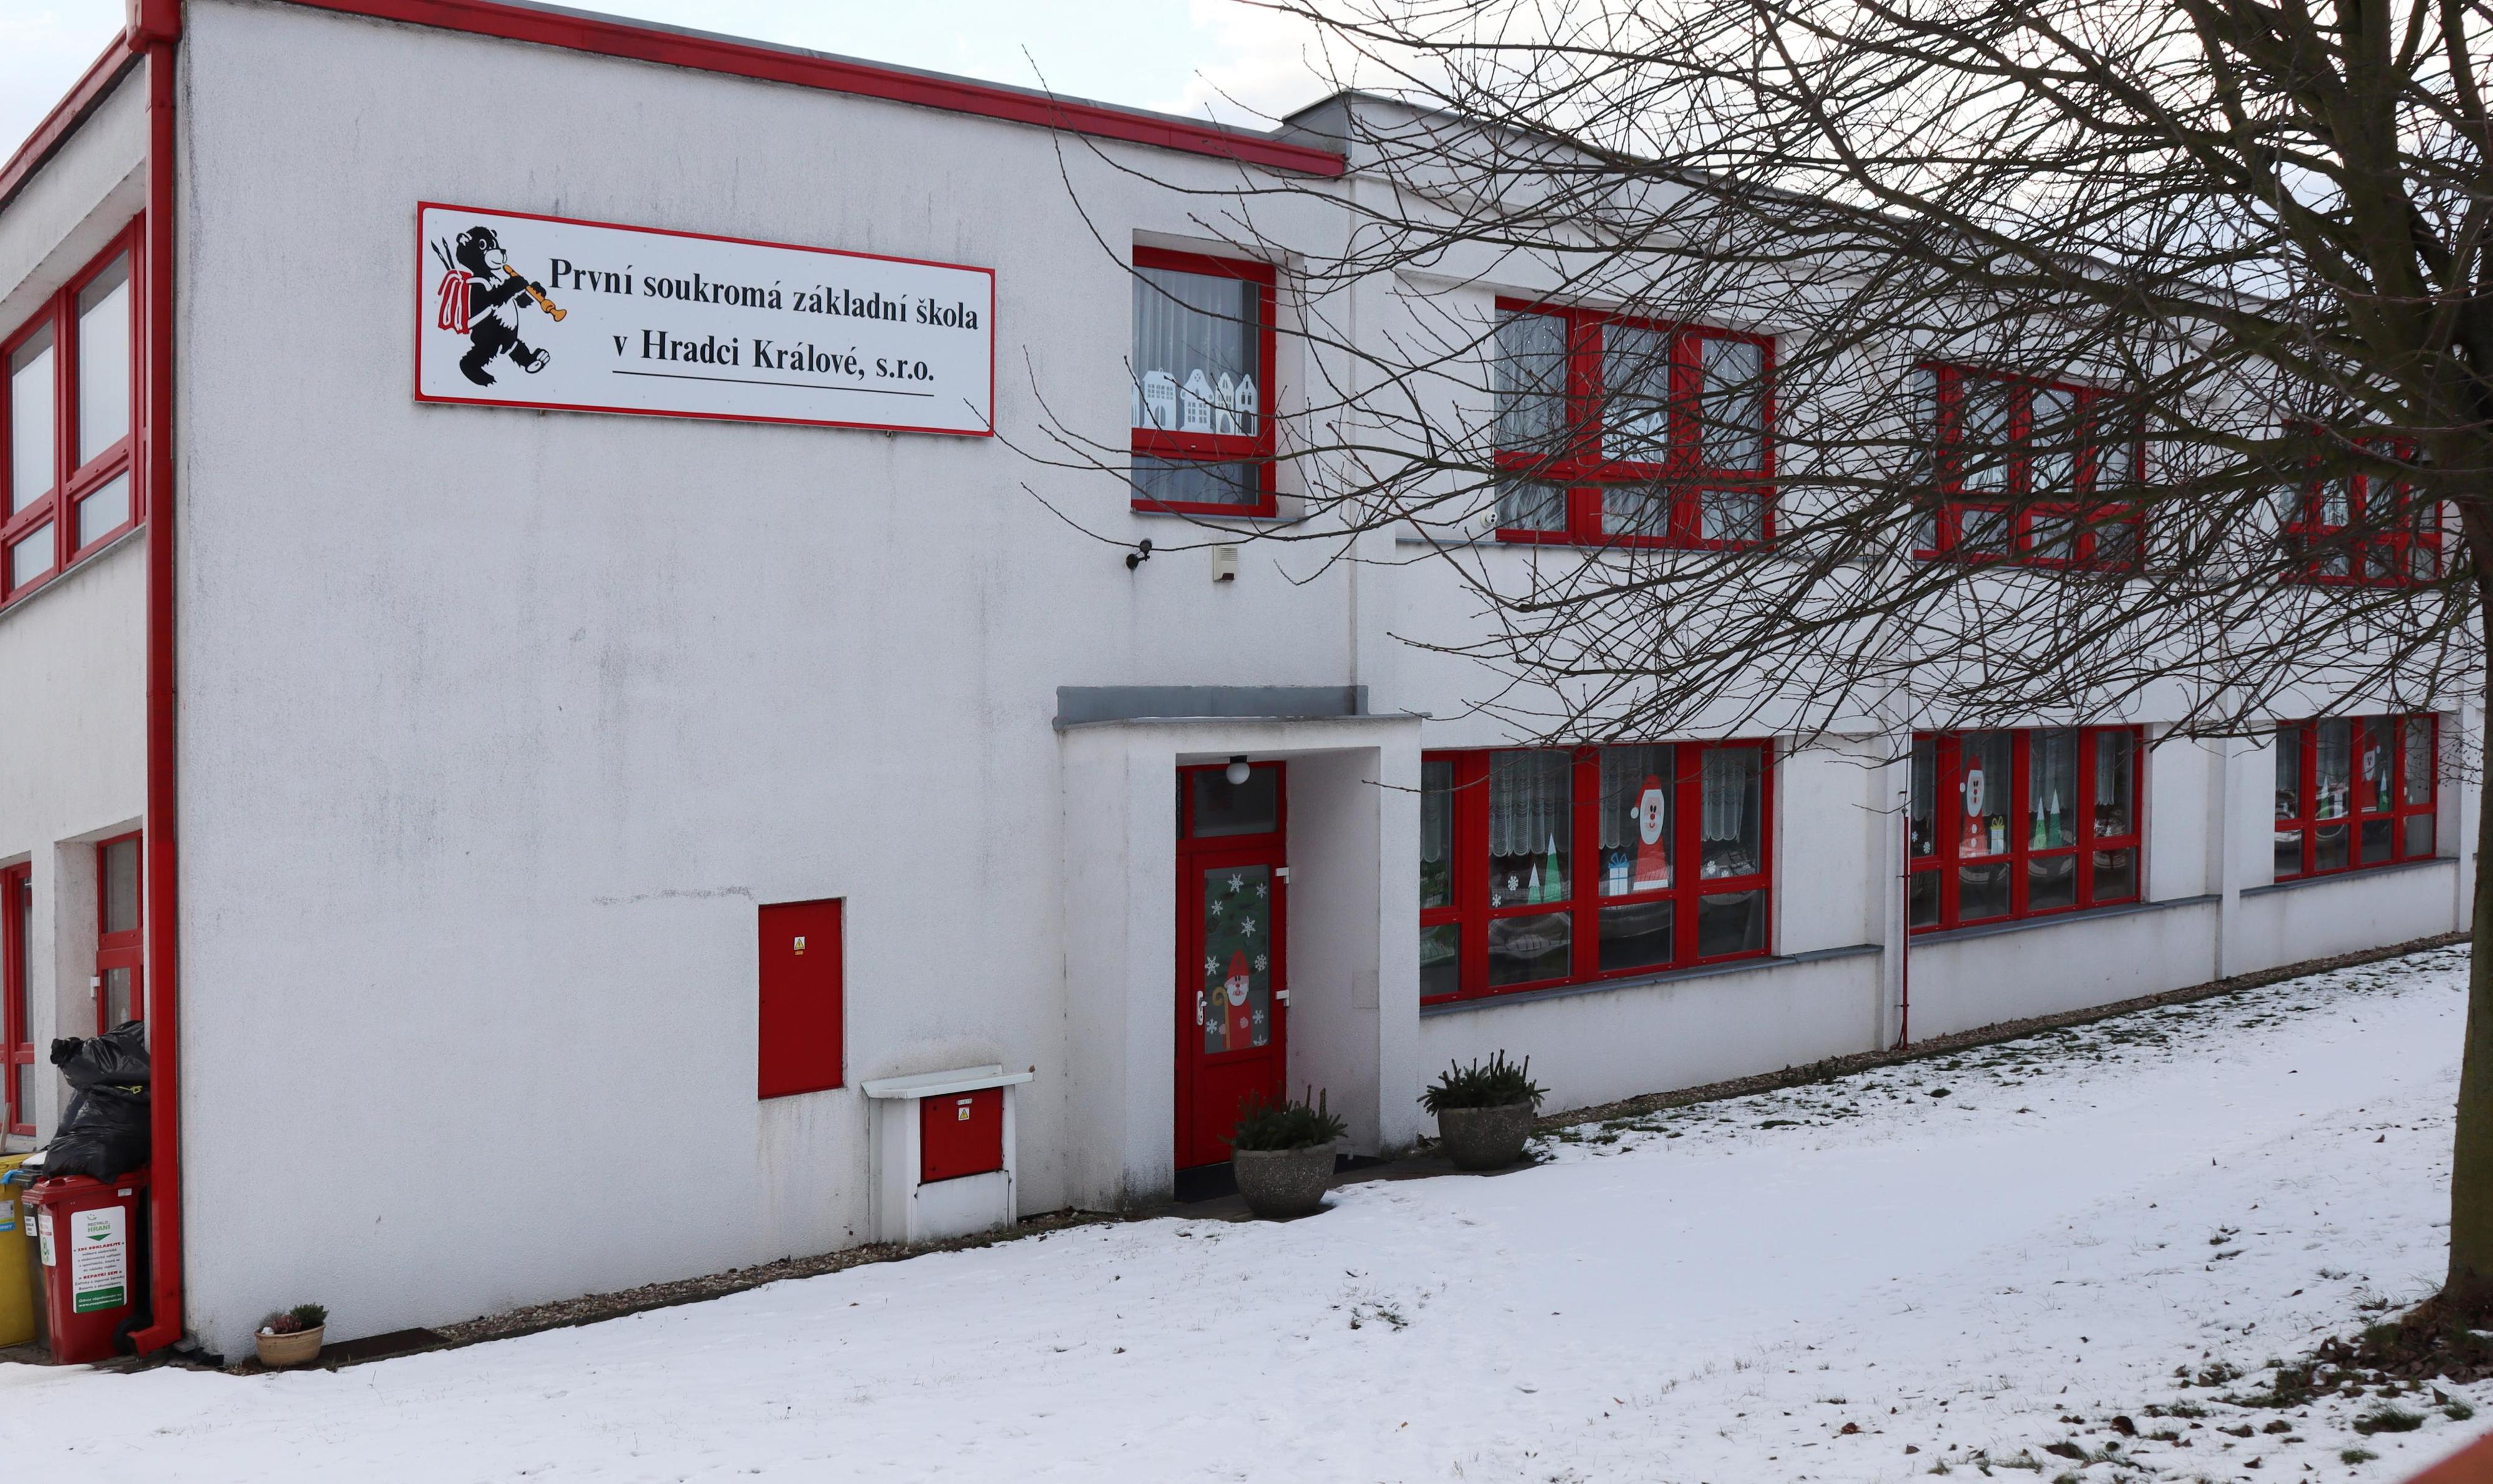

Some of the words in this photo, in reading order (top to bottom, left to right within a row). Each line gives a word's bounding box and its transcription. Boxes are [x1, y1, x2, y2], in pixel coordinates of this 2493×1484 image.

[549, 257, 633, 295] První
[643, 272, 783, 310] soukromá
[793, 285, 907, 322] základní
[916, 298, 979, 330] škola
[613, 335, 628, 357] v
[641, 330, 740, 366] Hradci
[753, 339, 866, 381] Králové,
[876, 358, 935, 381] s.r.o.
[87, 1223, 110, 1232] HRANÍ
